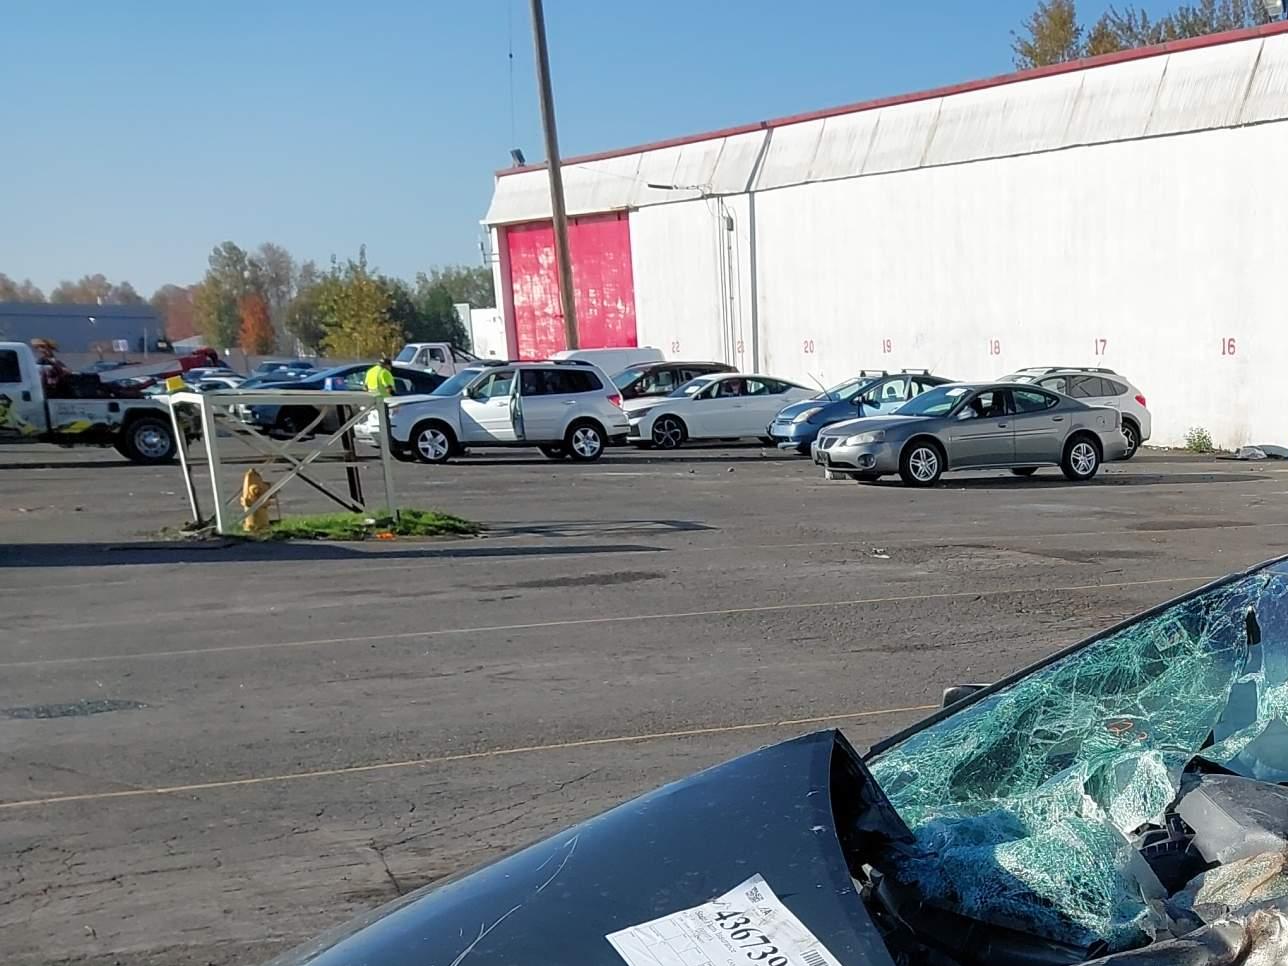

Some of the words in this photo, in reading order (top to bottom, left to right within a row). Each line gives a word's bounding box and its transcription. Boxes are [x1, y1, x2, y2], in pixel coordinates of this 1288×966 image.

[803, 339, 815, 353] 20
[882, 339, 892, 353] 19
[989, 339, 1001, 355] 18
[1094, 338, 1107, 355] 17
[1221, 337, 1236, 355] 16
